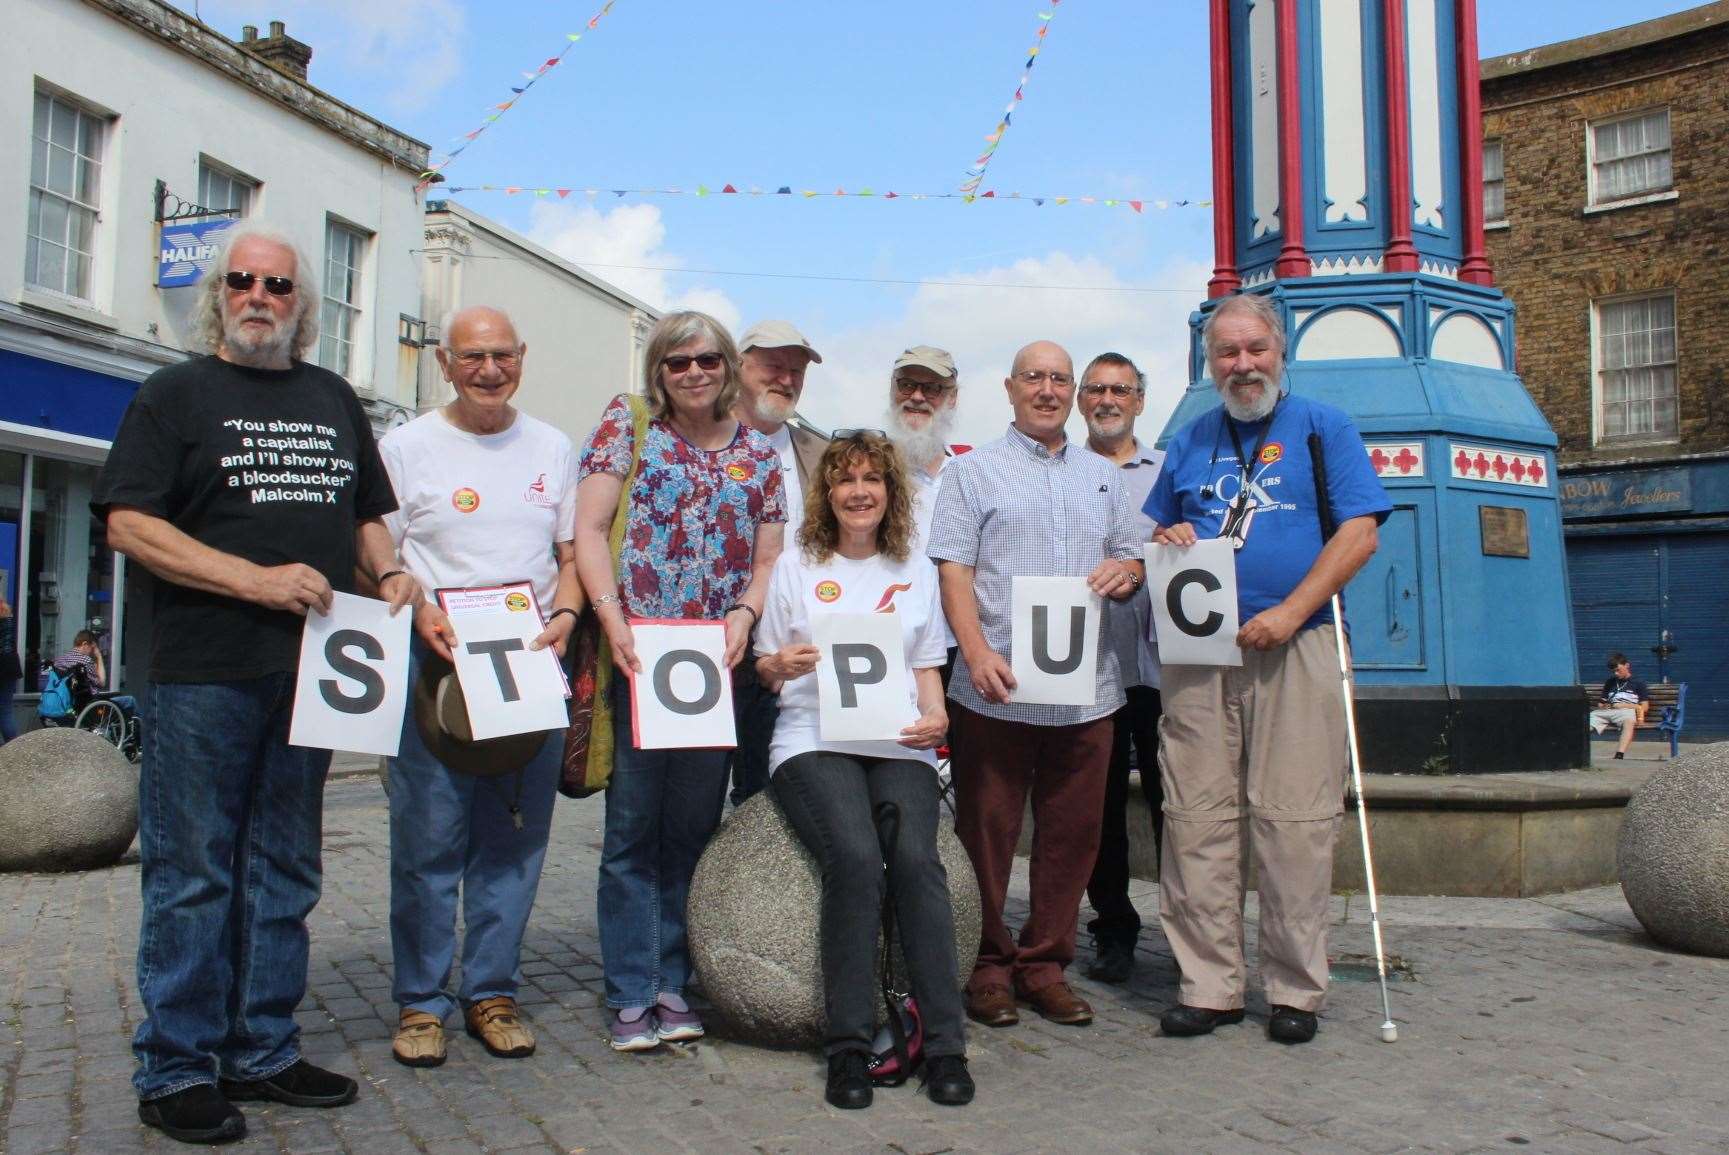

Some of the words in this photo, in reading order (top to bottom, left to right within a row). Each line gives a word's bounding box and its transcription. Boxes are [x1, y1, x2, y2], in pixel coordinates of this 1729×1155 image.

[162, 246, 219, 264] HALIFA
[223, 419, 266, 432] “You
[268, 420, 313, 433] show
[316, 424, 337, 437] me
[242, 437, 254, 447] a
[257, 437, 334, 451] capitalist
[221, 451, 254, 468] and
[258, 451, 279, 465] I’ll
[282, 452, 327, 467] show
[330, 457, 355, 473] you
[228, 475, 240, 487] a
[243, 470, 352, 487] bloodsucker”
[251, 488, 323, 504] Malcolm
[325, 490, 336, 504] X
[1166, 568, 1225, 637] C
[1032, 606, 1087, 675] U
[318, 629, 385, 715] S
[466, 638, 524, 702] T
[653, 649, 722, 715] O
[832, 643, 887, 708] P
